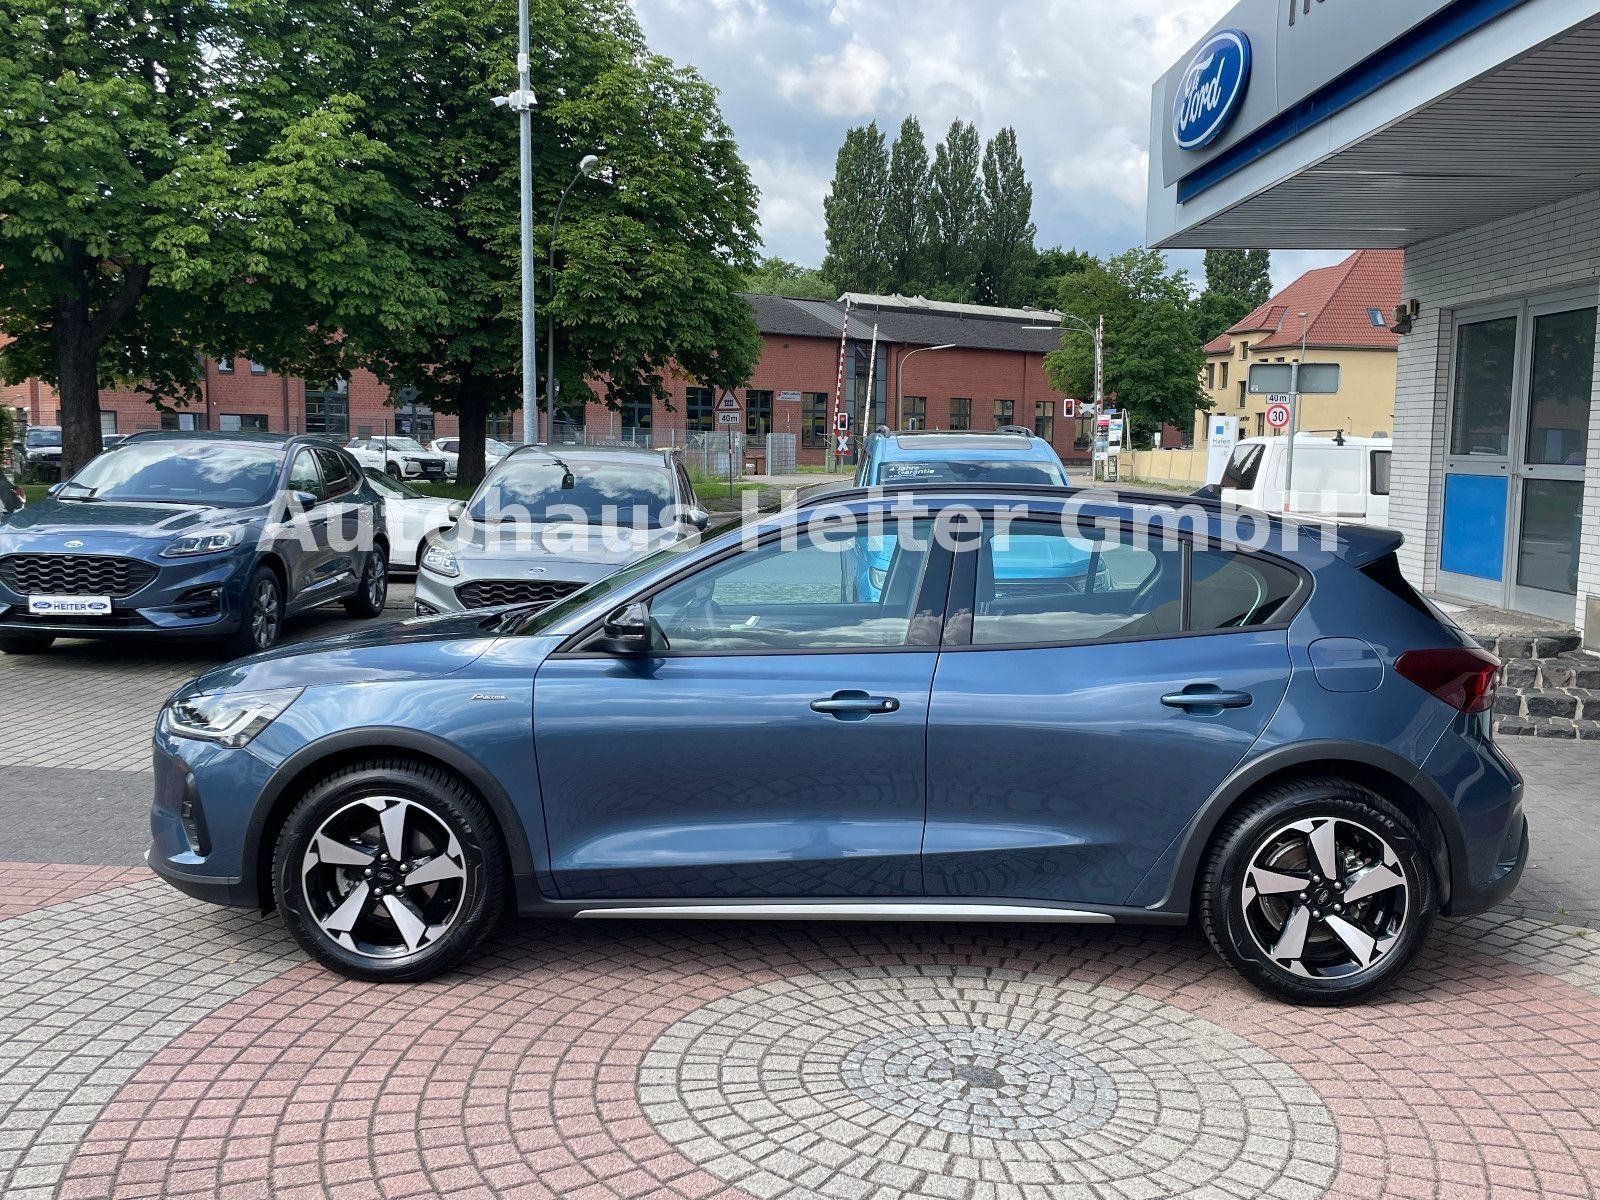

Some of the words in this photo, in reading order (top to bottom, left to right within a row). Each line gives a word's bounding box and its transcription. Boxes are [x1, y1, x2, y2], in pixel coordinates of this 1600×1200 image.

[1180, 52, 1226, 132] Ford
[721, 414, 738, 422] 40m
[1272, 411, 1284, 422] 30
[53, 603, 87, 611] HEITER
